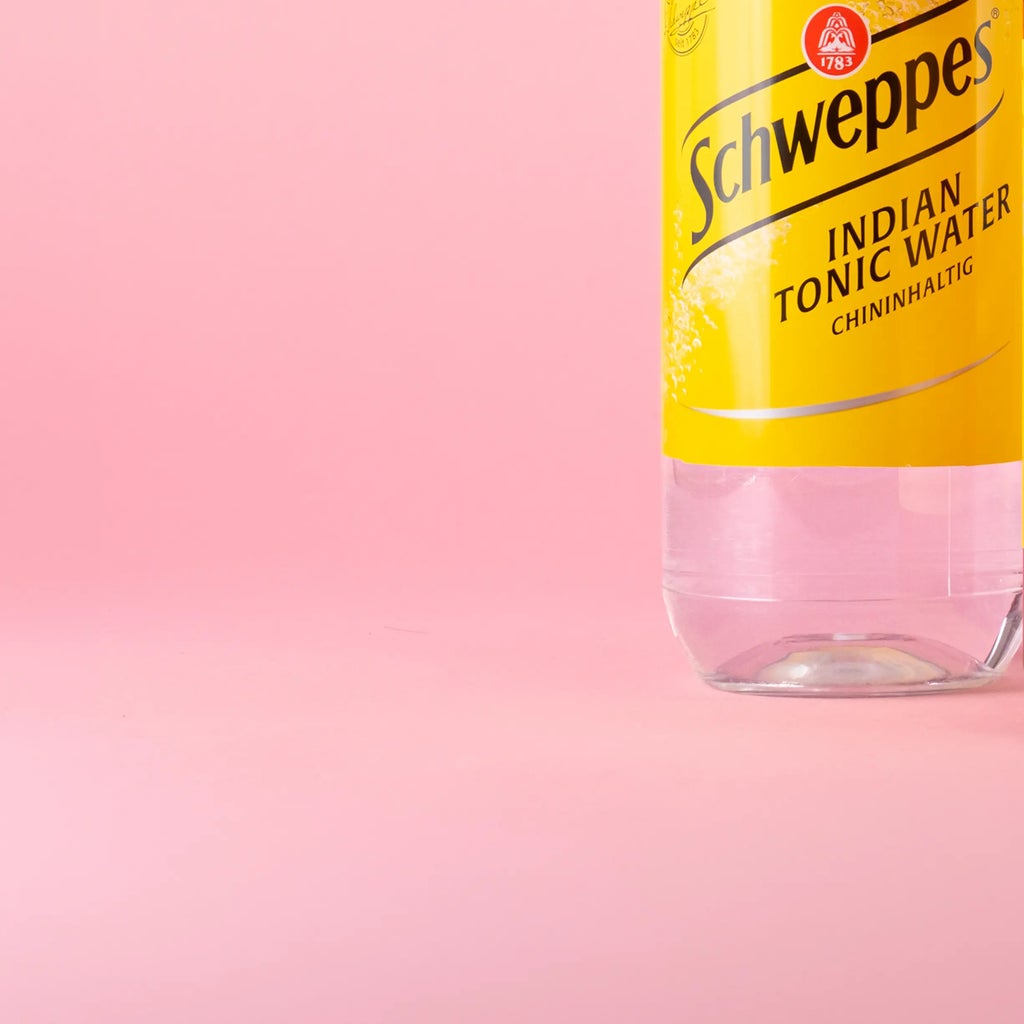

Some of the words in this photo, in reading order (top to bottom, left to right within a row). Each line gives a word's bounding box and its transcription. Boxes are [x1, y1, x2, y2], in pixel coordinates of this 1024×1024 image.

[820, 56, 853, 71] 1783
[690, 19, 993, 245] Schweppes
[774, 245, 891, 323] TONIC
[903, 183, 1011, 268] WATER
[828, 172, 961, 262] INDIAN
[831, 255, 974, 336] CHININHALTIG
